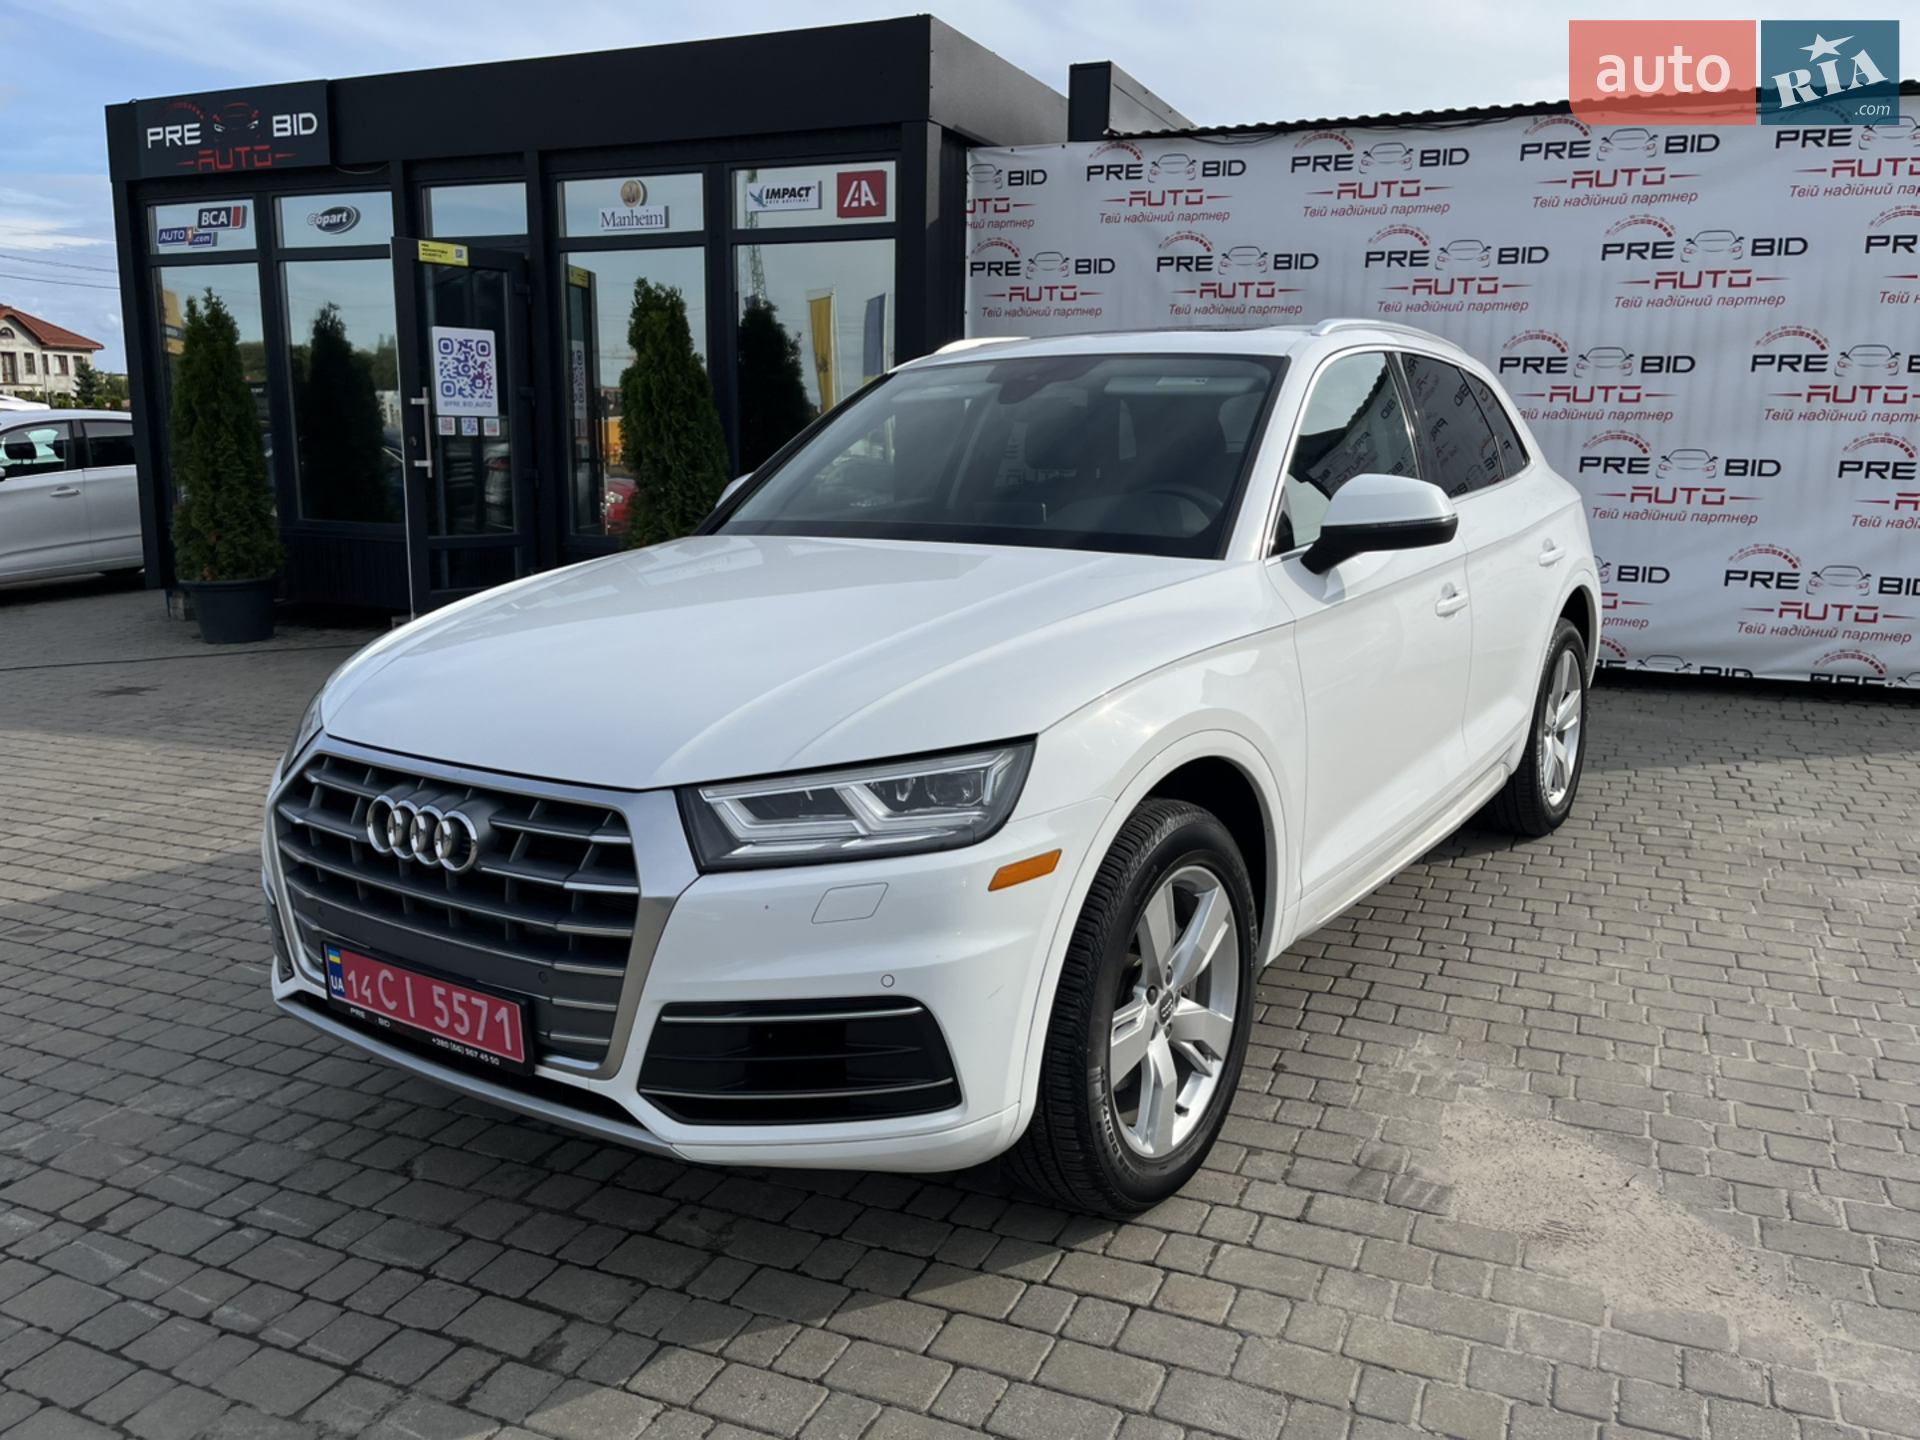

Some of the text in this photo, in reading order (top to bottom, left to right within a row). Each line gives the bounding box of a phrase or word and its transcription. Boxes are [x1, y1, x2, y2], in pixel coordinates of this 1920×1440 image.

[147, 112, 318, 149] PRE BID
[1775, 128, 1853, 148] PRE
[1520, 134, 1720, 162] PRE BID
[198, 145, 272, 171] AUTO
[1291, 148, 1470, 173] PRE BID
[1008, 170, 1047, 186] BID
[1086, 160, 1246, 182] PRE BID
[1571, 166, 1666, 189] AUTO
[766, 186, 812, 200] IMPACT
[1128, 188, 1204, 207] AUTO
[1337, 179, 1421, 200] AUTO
[1790, 184, 1820, 198] Твій
[1823, 182, 1894, 197] надійний
[1532, 192, 1698, 209] Твій надійний партнер
[201, 210, 228, 226] BCA
[307, 210, 349, 226] Copart
[601, 209, 664, 228] Manheim
[1099, 211, 1230, 224] Твій надійний партнер
[1303, 203, 1450, 218] Твій надійний партнер
[988, 219, 1034, 230] партнер
[1365, 246, 1550, 268] PRE BID
[1601, 237, 1808, 261] PRE BID
[970, 258, 1116, 277] PRE BID
[1156, 253, 1319, 272] PRE BID
[1412, 276, 1499, 296] AUTO
[1654, 269, 1752, 290] AUTO
[1008, 285, 1077, 302] AUTO
[1200, 281, 1276, 299] AUTO
[1880, 291, 1910, 304] Твій
[1169, 303, 1302, 316] Твій надійний партнер
[1376, 300, 1529, 314] Твій надійний партнер
[1614, 294, 1786, 308] Твій надійний партнер
[982, 306, 1102, 318] Твій надійний партнер
[1499, 355, 1696, 374] PRE BID
[1751, 354, 1829, 372] PRE
[1549, 385, 1642, 403] AUTO
[1806, 385, 1908, 404] AUTO
[1542, 408, 1604, 421] надійний
[1608, 409, 1674, 422] партнер
[1764, 408, 1794, 421] Твій
[1798, 408, 1868, 422] надійний
[1579, 456, 1782, 477] PRE BID
[1838, 460, 1918, 480] PRE
[1630, 486, 1726, 506] AUTO
[1592, 508, 1758, 526] Твій надійний партнер
[1852, 514, 1882, 528] Твій
[1617, 564, 1670, 584] BID
[1724, 570, 1800, 590] PRE
[1778, 601, 1879, 624] AUTO
[1737, 622, 1912, 645] Твій надійний партнер
[330, 975, 344, 992] UA
[432, 985, 512, 1051] 5571
